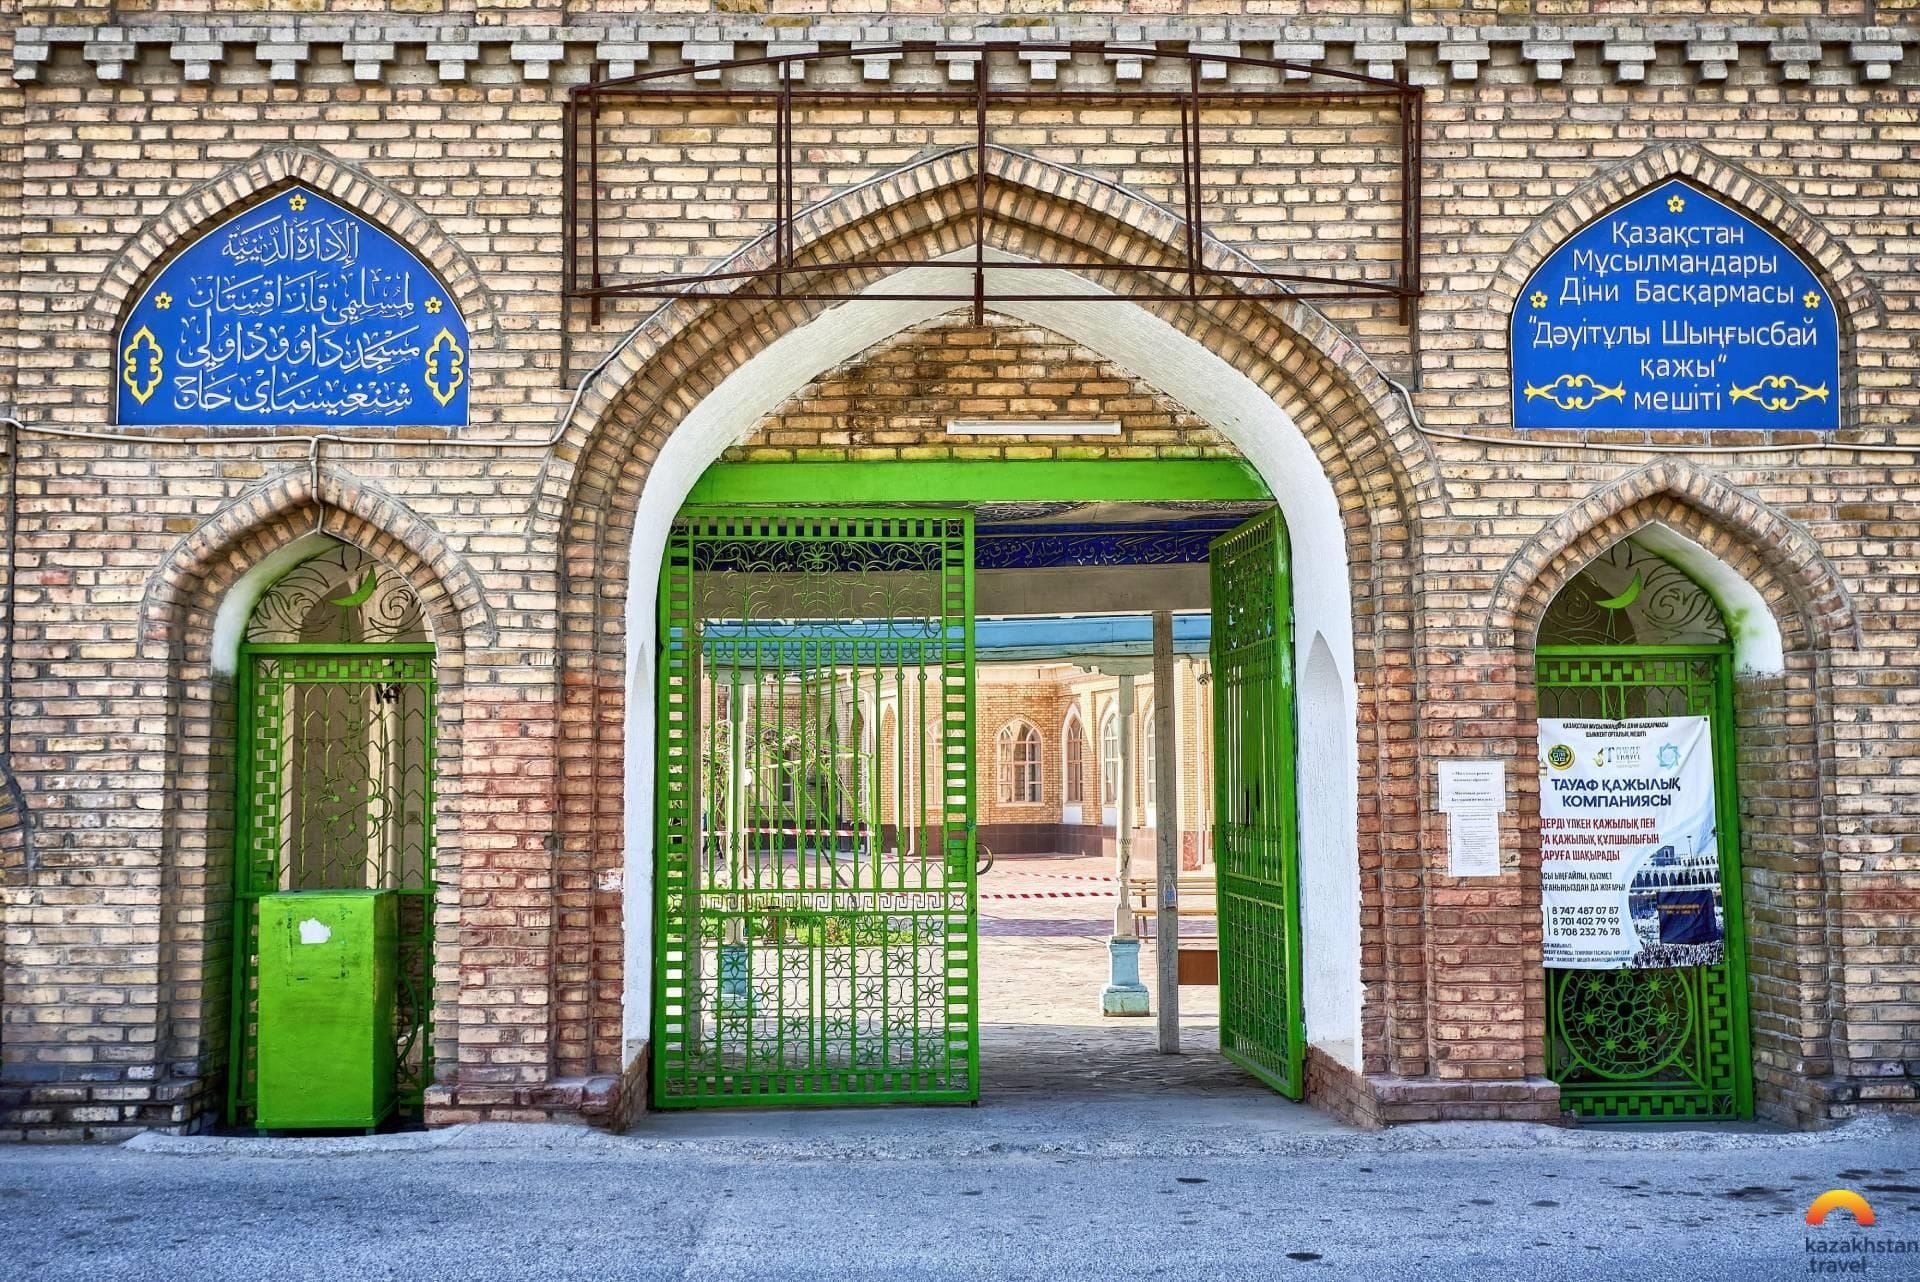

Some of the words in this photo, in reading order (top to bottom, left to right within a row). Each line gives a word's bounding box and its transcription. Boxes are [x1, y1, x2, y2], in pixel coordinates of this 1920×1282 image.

[1611, 220, 1744, 248] Қазақстан
[1573, 248, 1778, 278] Мұсылмандары
[1559, 276, 1620, 305] Діни
[1635, 279, 1795, 307] Басқармасы
[1661, 316, 1818, 349] Шыңғысбай
[1633, 383, 1722, 411] мешіті
[1551, 778, 1599, 791] ТАУАФ
[1602, 777, 1681, 793] ҚАЖЫЛЫҚ
[1562, 794, 1671, 808] КОМПАНИЯСЫ
[1593, 818, 1639, 830] ҚАЖЫЛЫҚ
[1640, 817, 1656, 829] ПЕН
[1552, 834, 1597, 846] ҚАЖЫЛЫҚ
[1573, 850, 1620, 862] ШАҚЫРАДЫ
[1590, 883, 1599, 892] ДА
[1552, 906, 1558, 915] 8
[1560, 906, 1575, 915] 747
[1577, 906, 1594, 915] 487
[1595, 906, 1606, 915] 07
[1609, 906, 1619, 915] 87
[1552, 917, 1558, 925] 8
[1560, 917, 1574, 925] 701
[1576, 917, 1593, 925] 402
[1595, 917, 1606, 925] 79
[1608, 917, 1619, 925] 99
[1553, 928, 1559, 936] 8
[1562, 928, 1577, 936] 708
[1580, 928, 1596, 936] 232
[1597, 928, 1608, 936] 76
[1610, 928, 1621, 936] 78
